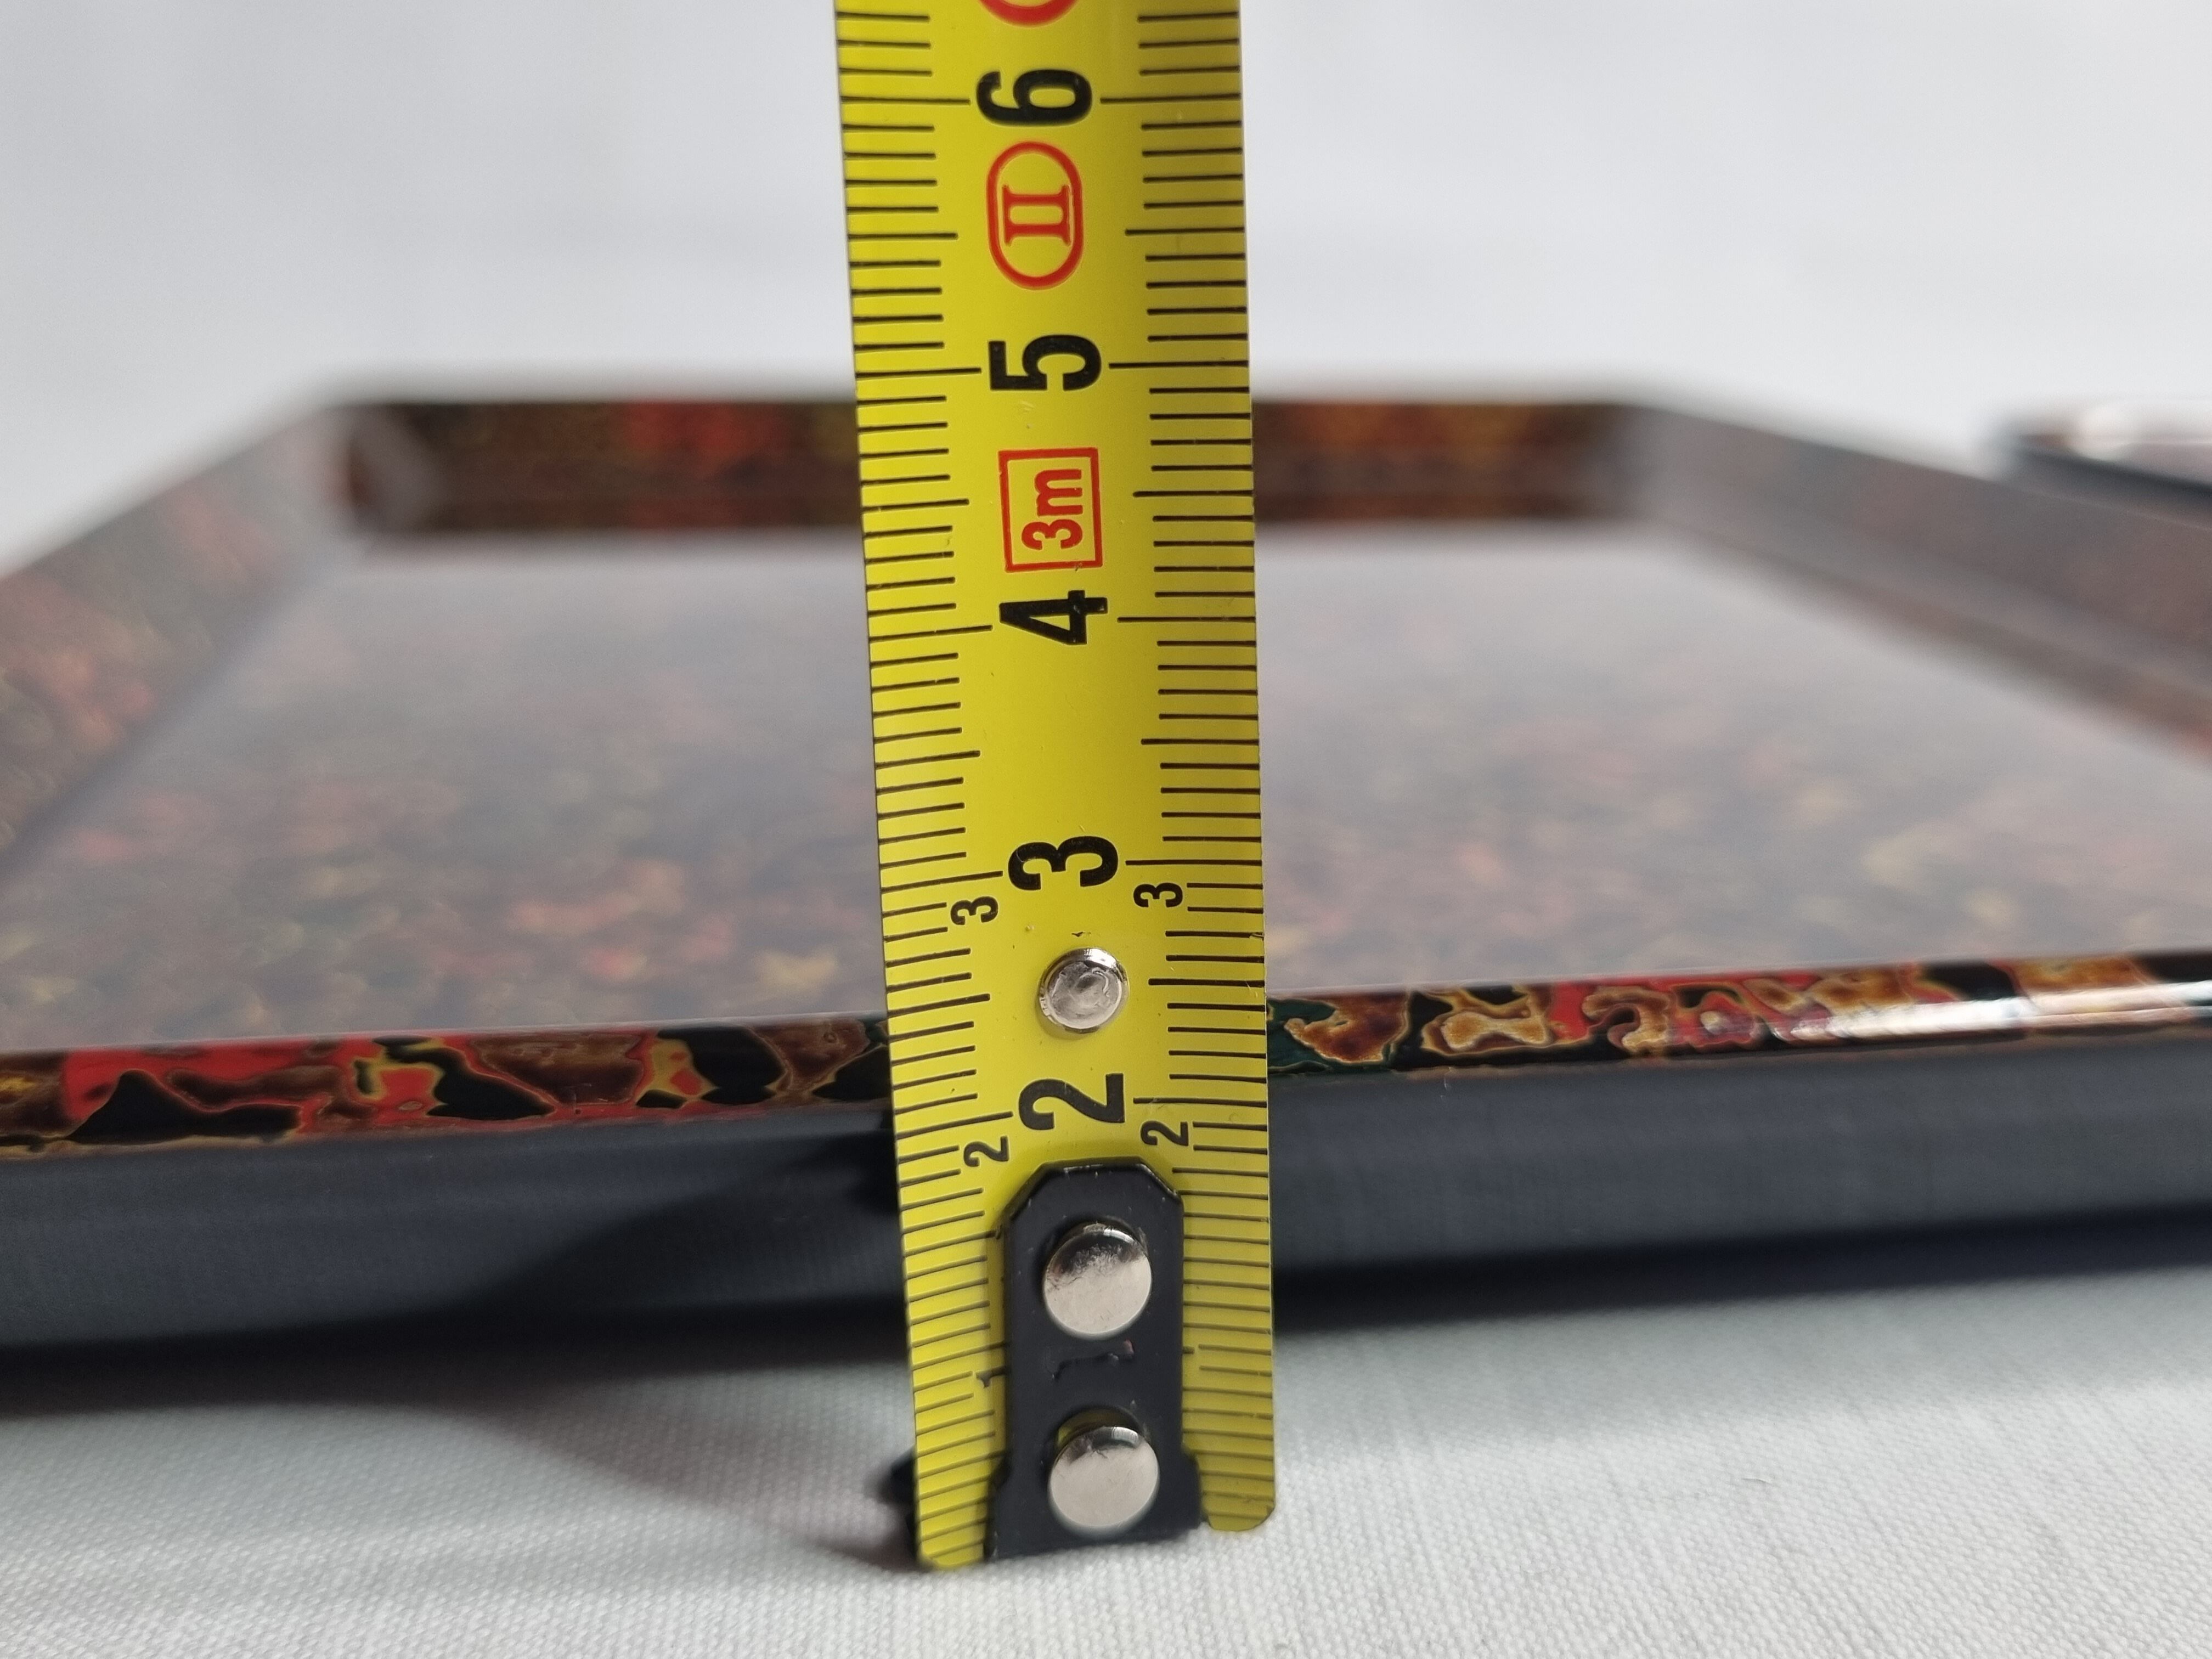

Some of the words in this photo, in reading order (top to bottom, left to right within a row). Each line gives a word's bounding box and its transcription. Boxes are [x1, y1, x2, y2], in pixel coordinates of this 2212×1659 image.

[976, 69, 1092, 127] 6
[988, 335, 1102, 391] 5
[1021, 469, 1084, 550] 3m
[999, 590, 1108, 645] 4
[1008, 836, 1118, 890] 3
[950, 895, 998, 925] 3
[1133, 882, 1183, 907] 3
[1018, 1073, 1125, 1130] 2
[963, 1136, 1009, 1167] 2
[1141, 1121, 1189, 1147] 2
